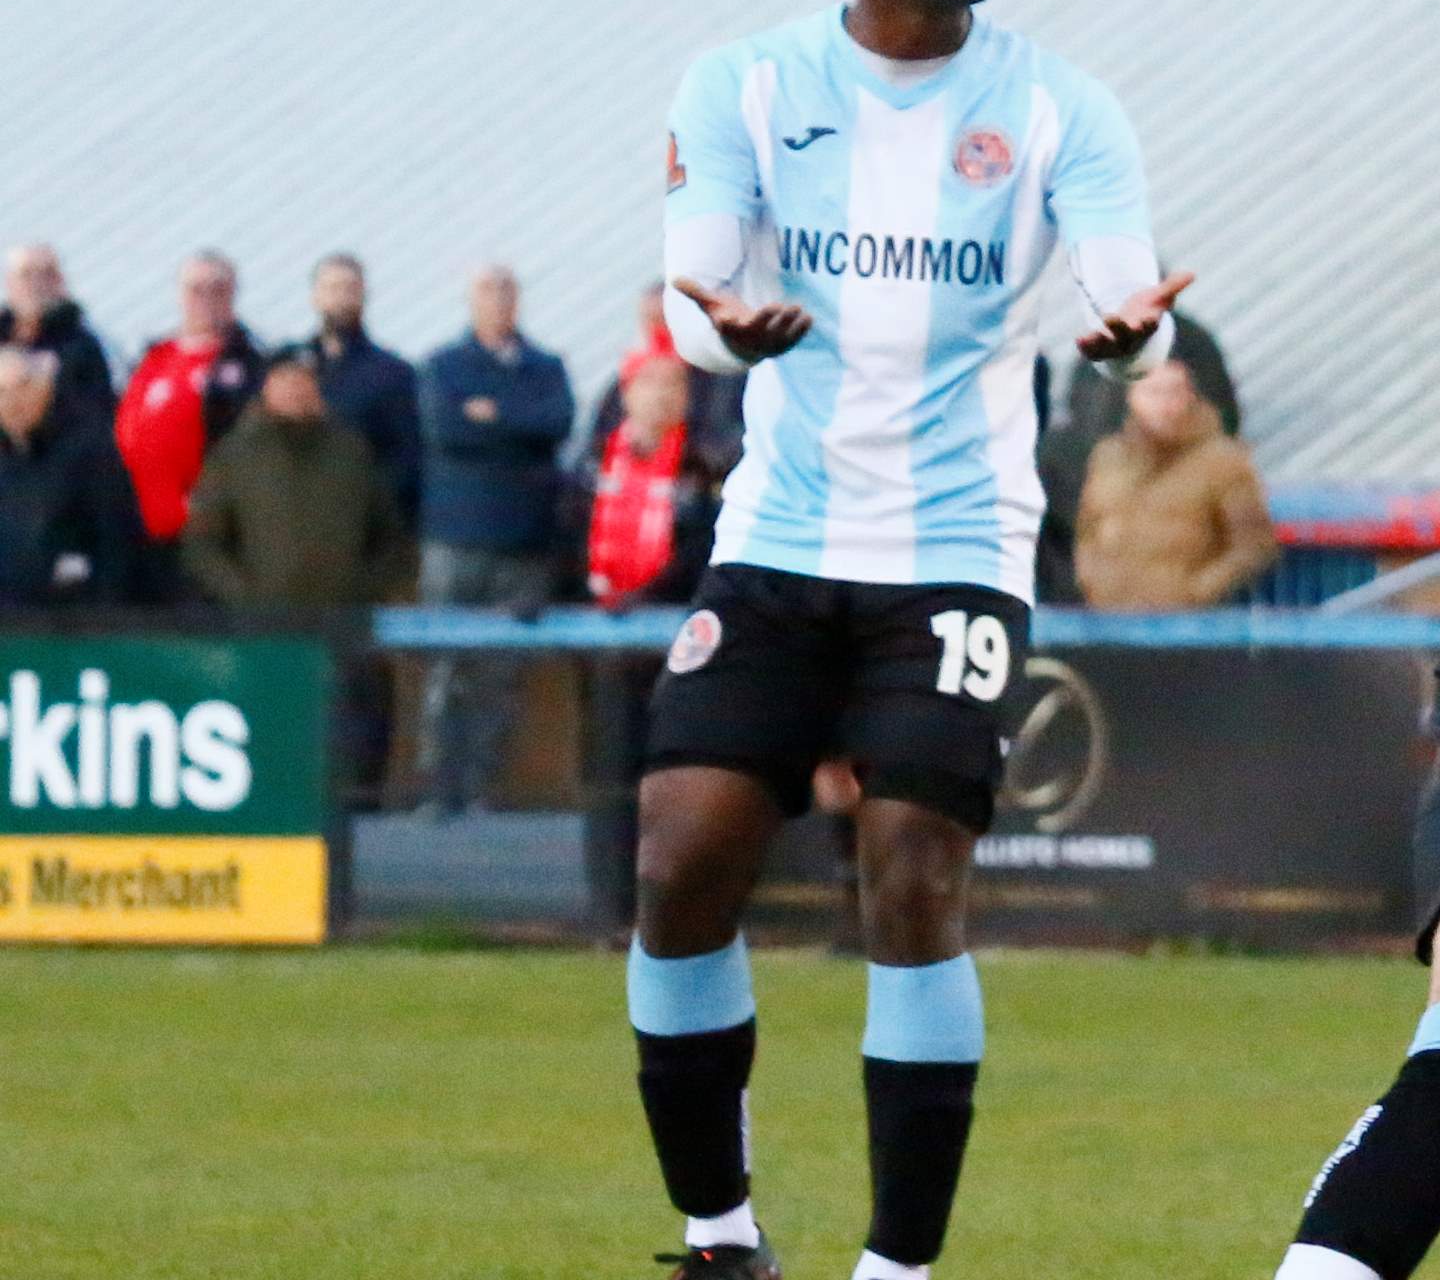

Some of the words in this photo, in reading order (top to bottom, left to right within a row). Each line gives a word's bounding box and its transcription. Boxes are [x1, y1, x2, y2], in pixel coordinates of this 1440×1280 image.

[930, 608, 1011, 703] 19
[0, 668, 252, 812] kins
[30, 856, 241, 910] Merchant
